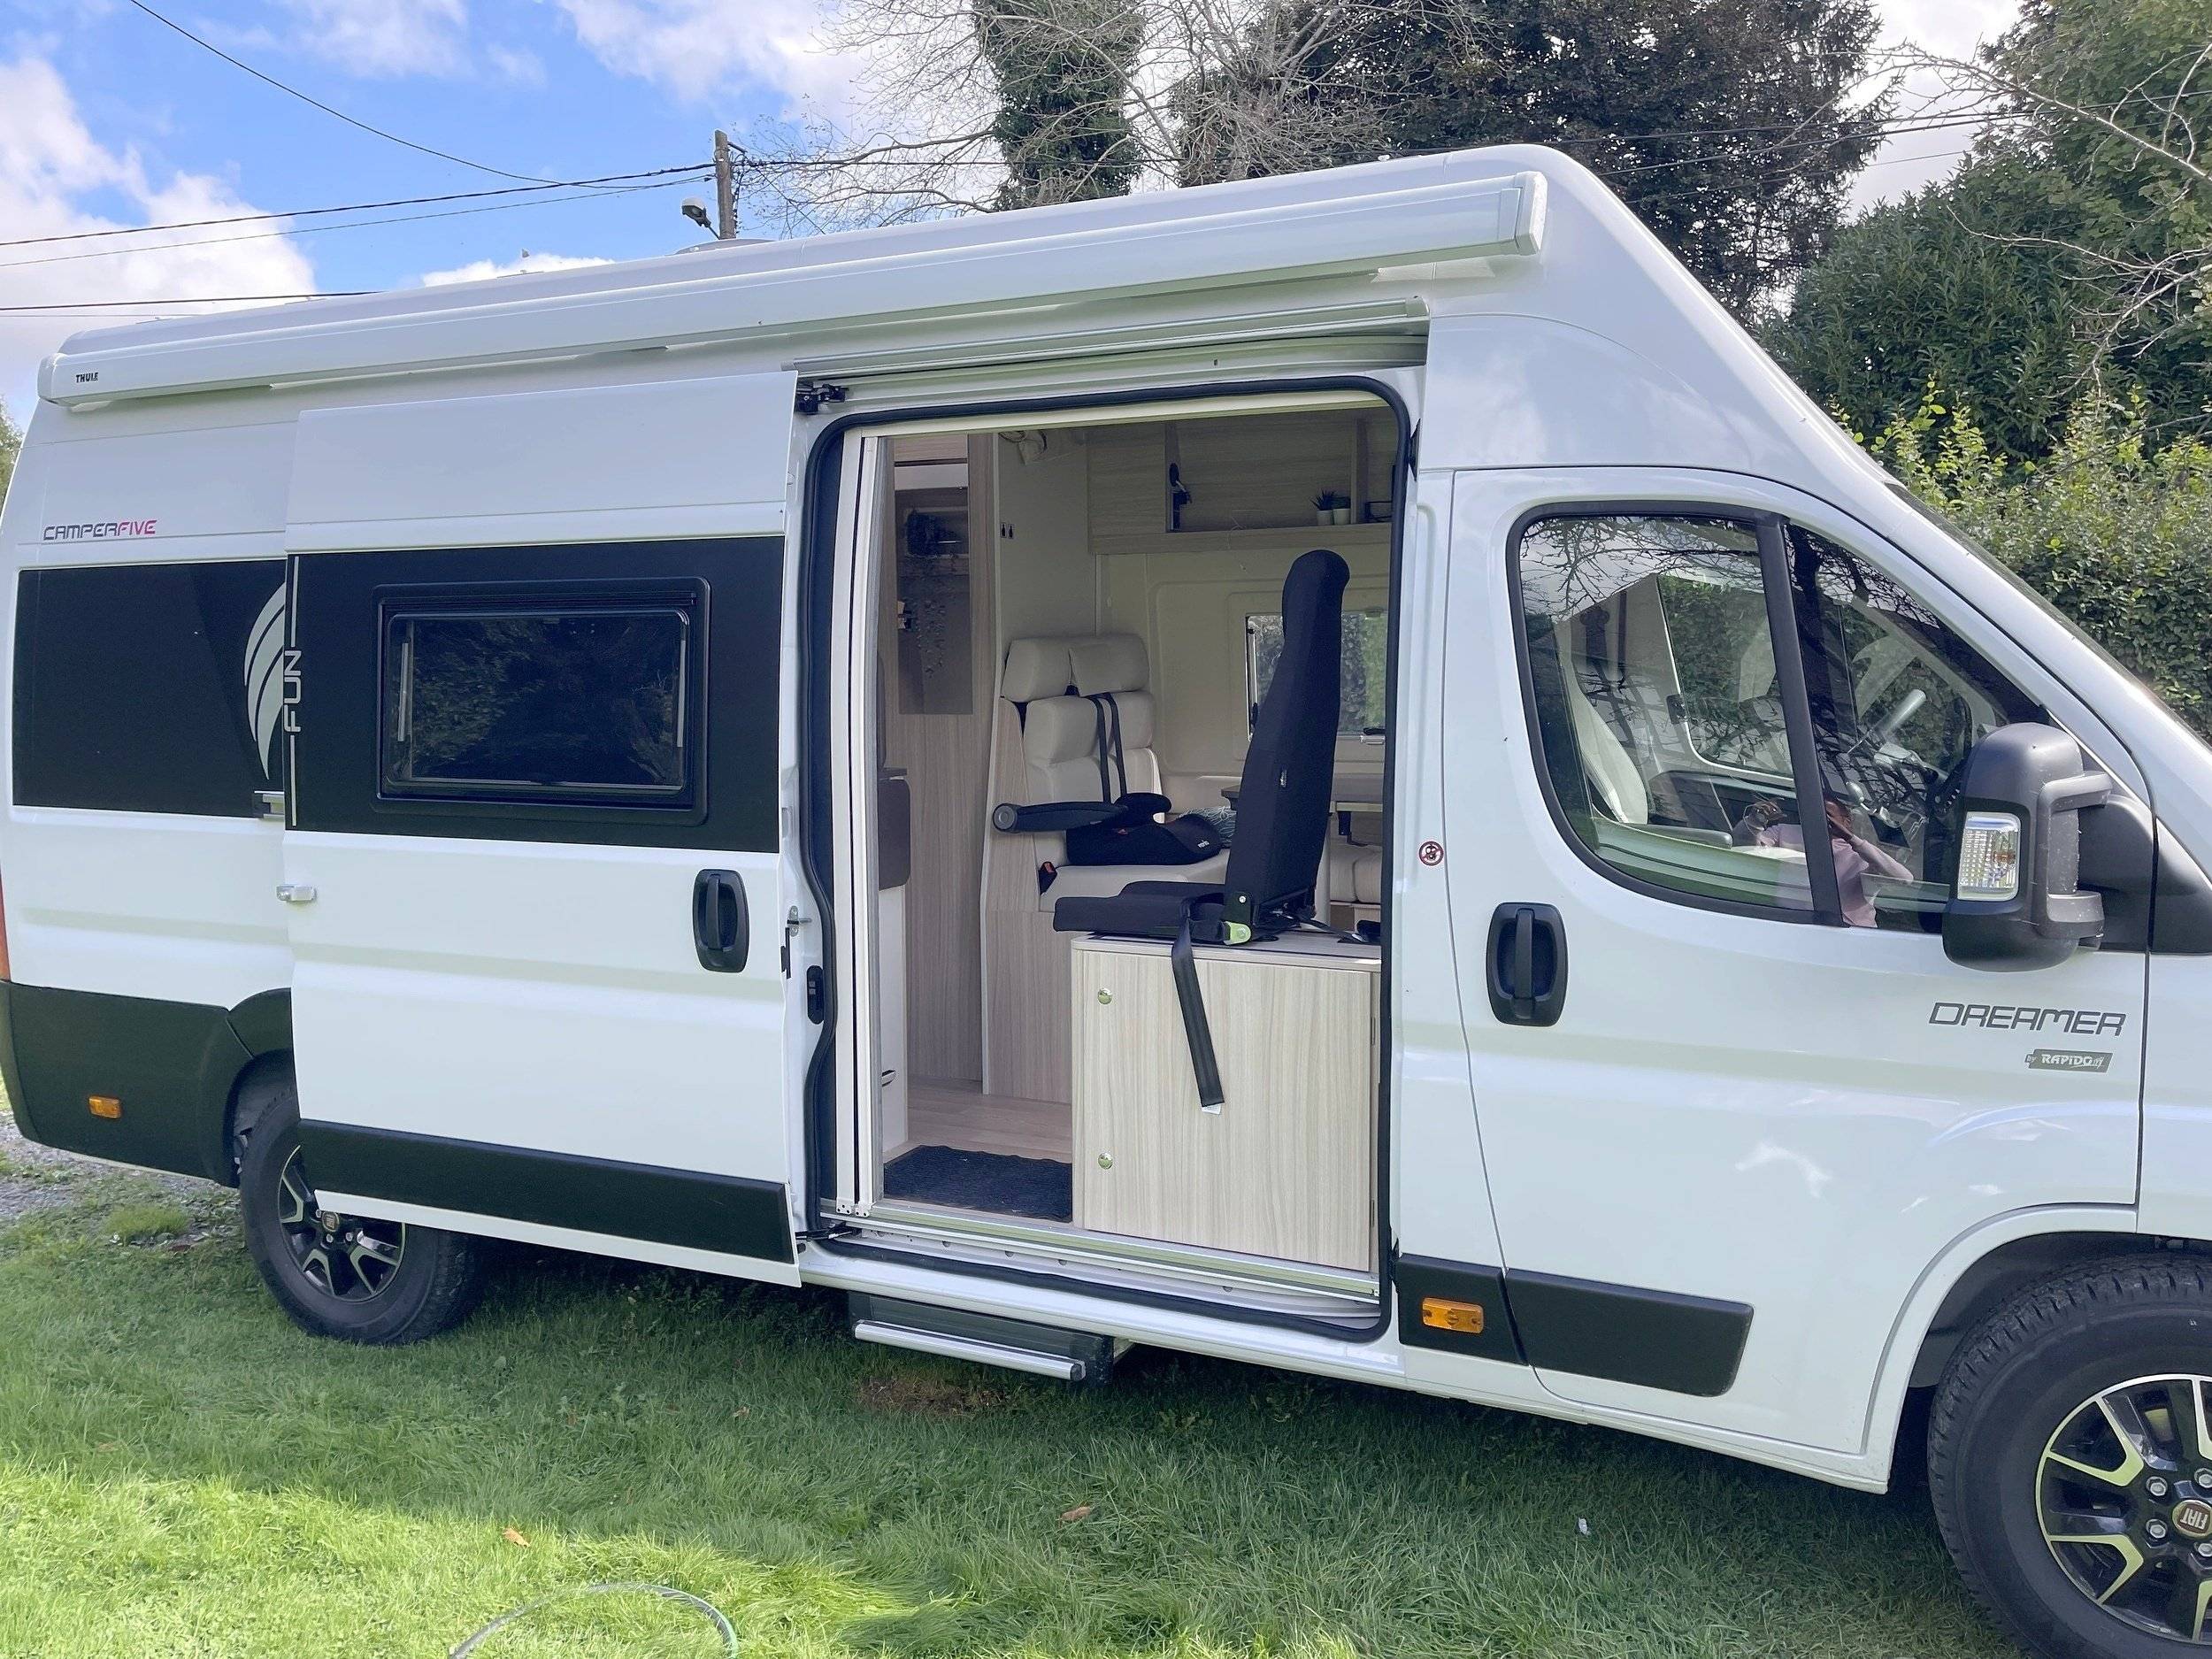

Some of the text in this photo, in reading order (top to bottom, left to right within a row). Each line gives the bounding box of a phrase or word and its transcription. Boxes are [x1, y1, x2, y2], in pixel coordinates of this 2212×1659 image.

[76, 372, 98, 382] THULE
[43, 520, 157, 541] CAMPERFIVE
[283, 649, 302, 733] FUN
[1929, 1002, 2126, 1036] DREAMER
[2040, 1054, 2096, 1067] RAPIDO
[2180, 1508, 2208, 1530] FIAT
